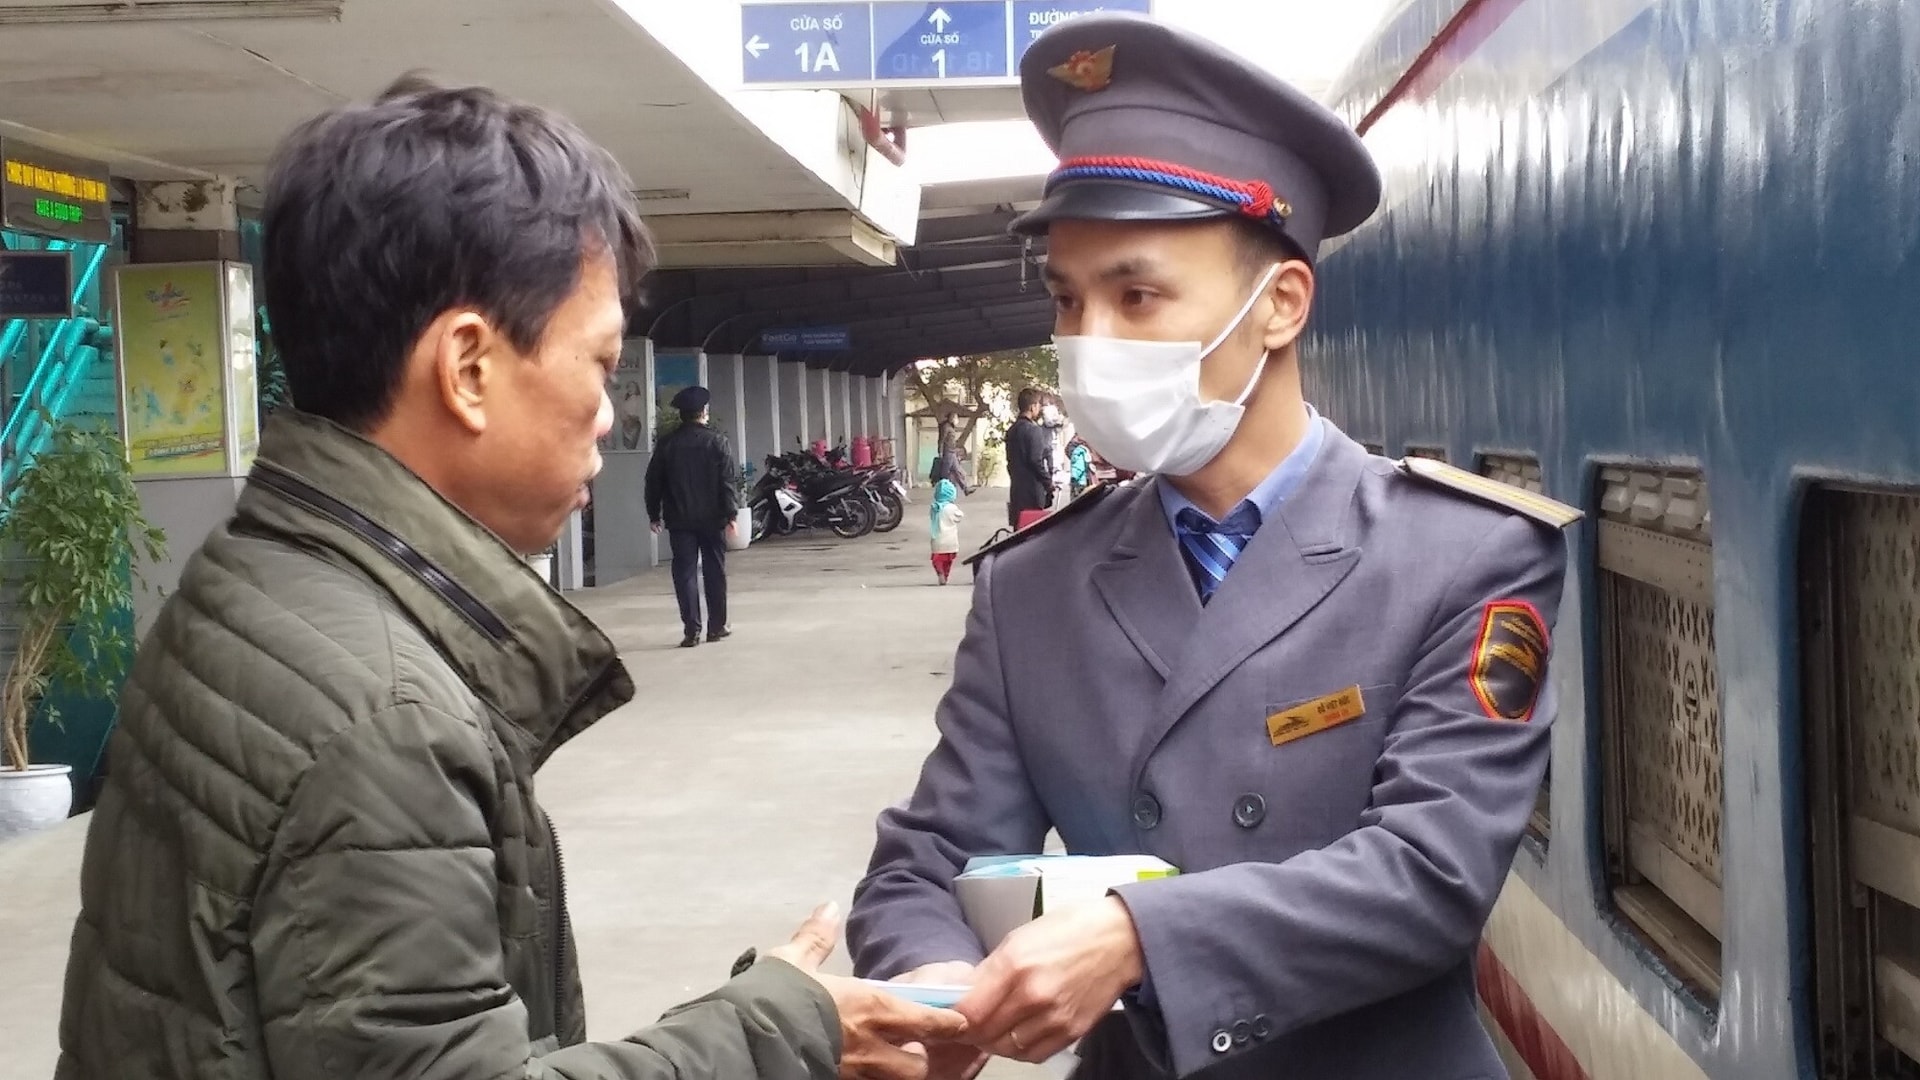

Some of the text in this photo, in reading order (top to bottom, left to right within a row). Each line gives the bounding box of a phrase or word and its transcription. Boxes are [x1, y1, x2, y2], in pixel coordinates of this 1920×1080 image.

[822, 12, 843, 31] SỐ
[794, 41, 841, 73] 1A
[931, 48, 946, 78] 1
